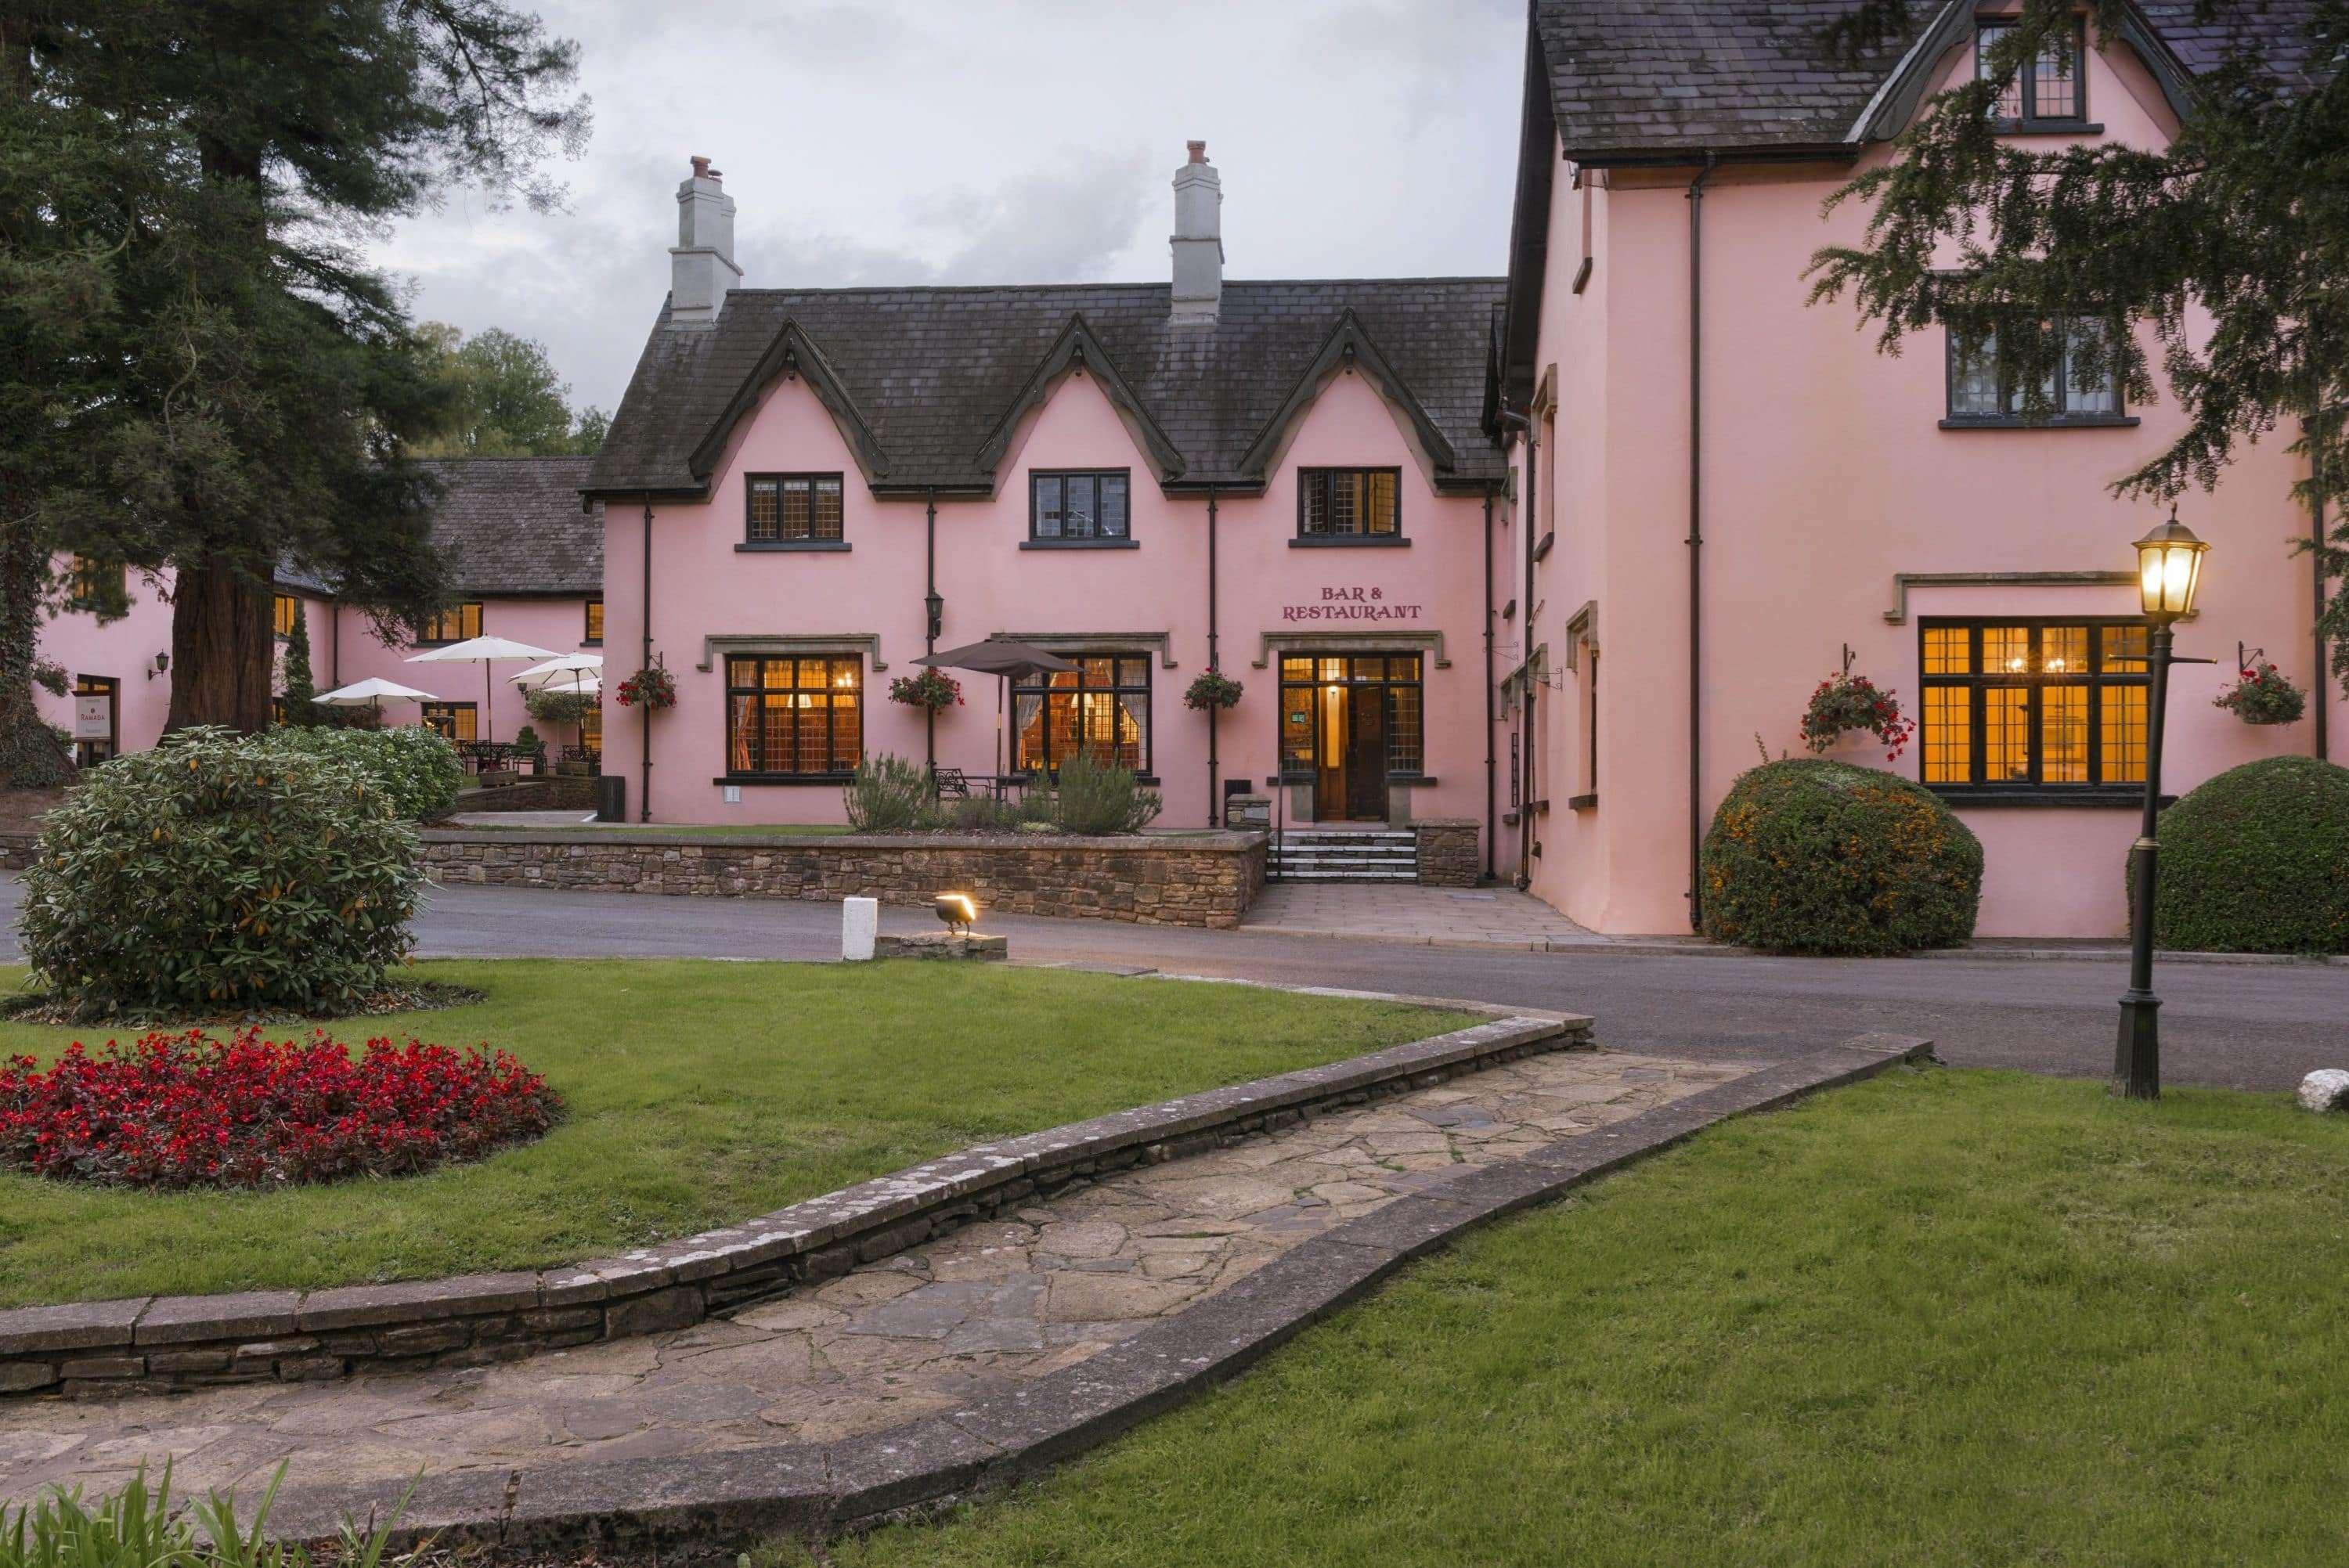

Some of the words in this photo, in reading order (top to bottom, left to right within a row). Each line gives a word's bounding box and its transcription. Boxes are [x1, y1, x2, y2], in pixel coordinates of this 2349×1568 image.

[1321, 587, 1366, 602] BAR
[1370, 587, 1382, 600] &
[1283, 605, 1422, 621] RESTAURANT
